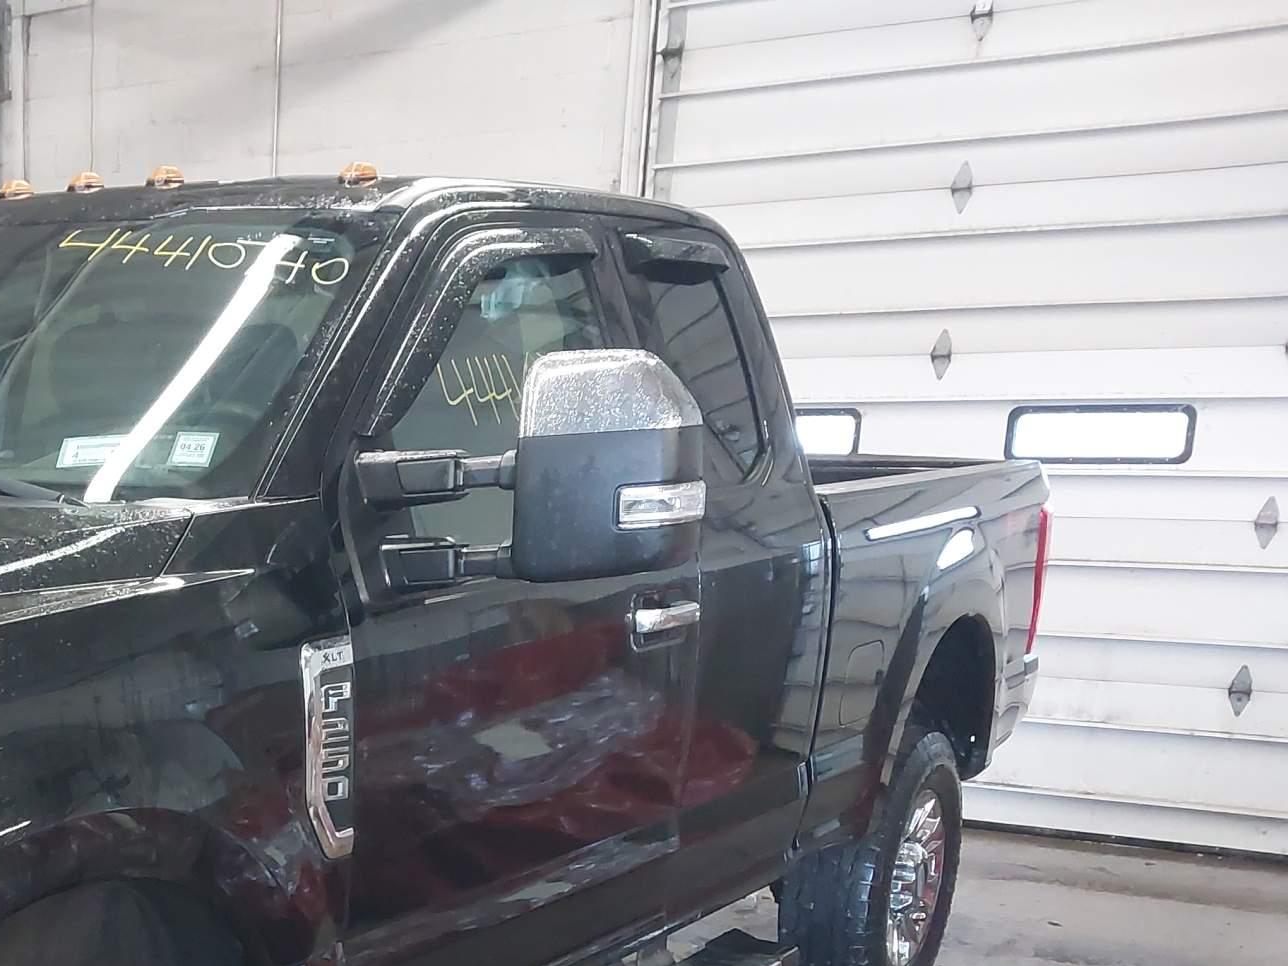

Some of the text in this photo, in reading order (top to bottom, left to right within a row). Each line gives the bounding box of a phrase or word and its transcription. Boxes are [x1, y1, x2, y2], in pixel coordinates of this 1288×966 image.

[437, 351, 536, 427] 4441
[322, 651, 344, 664] XLT
[321, 681, 351, 801] F250
